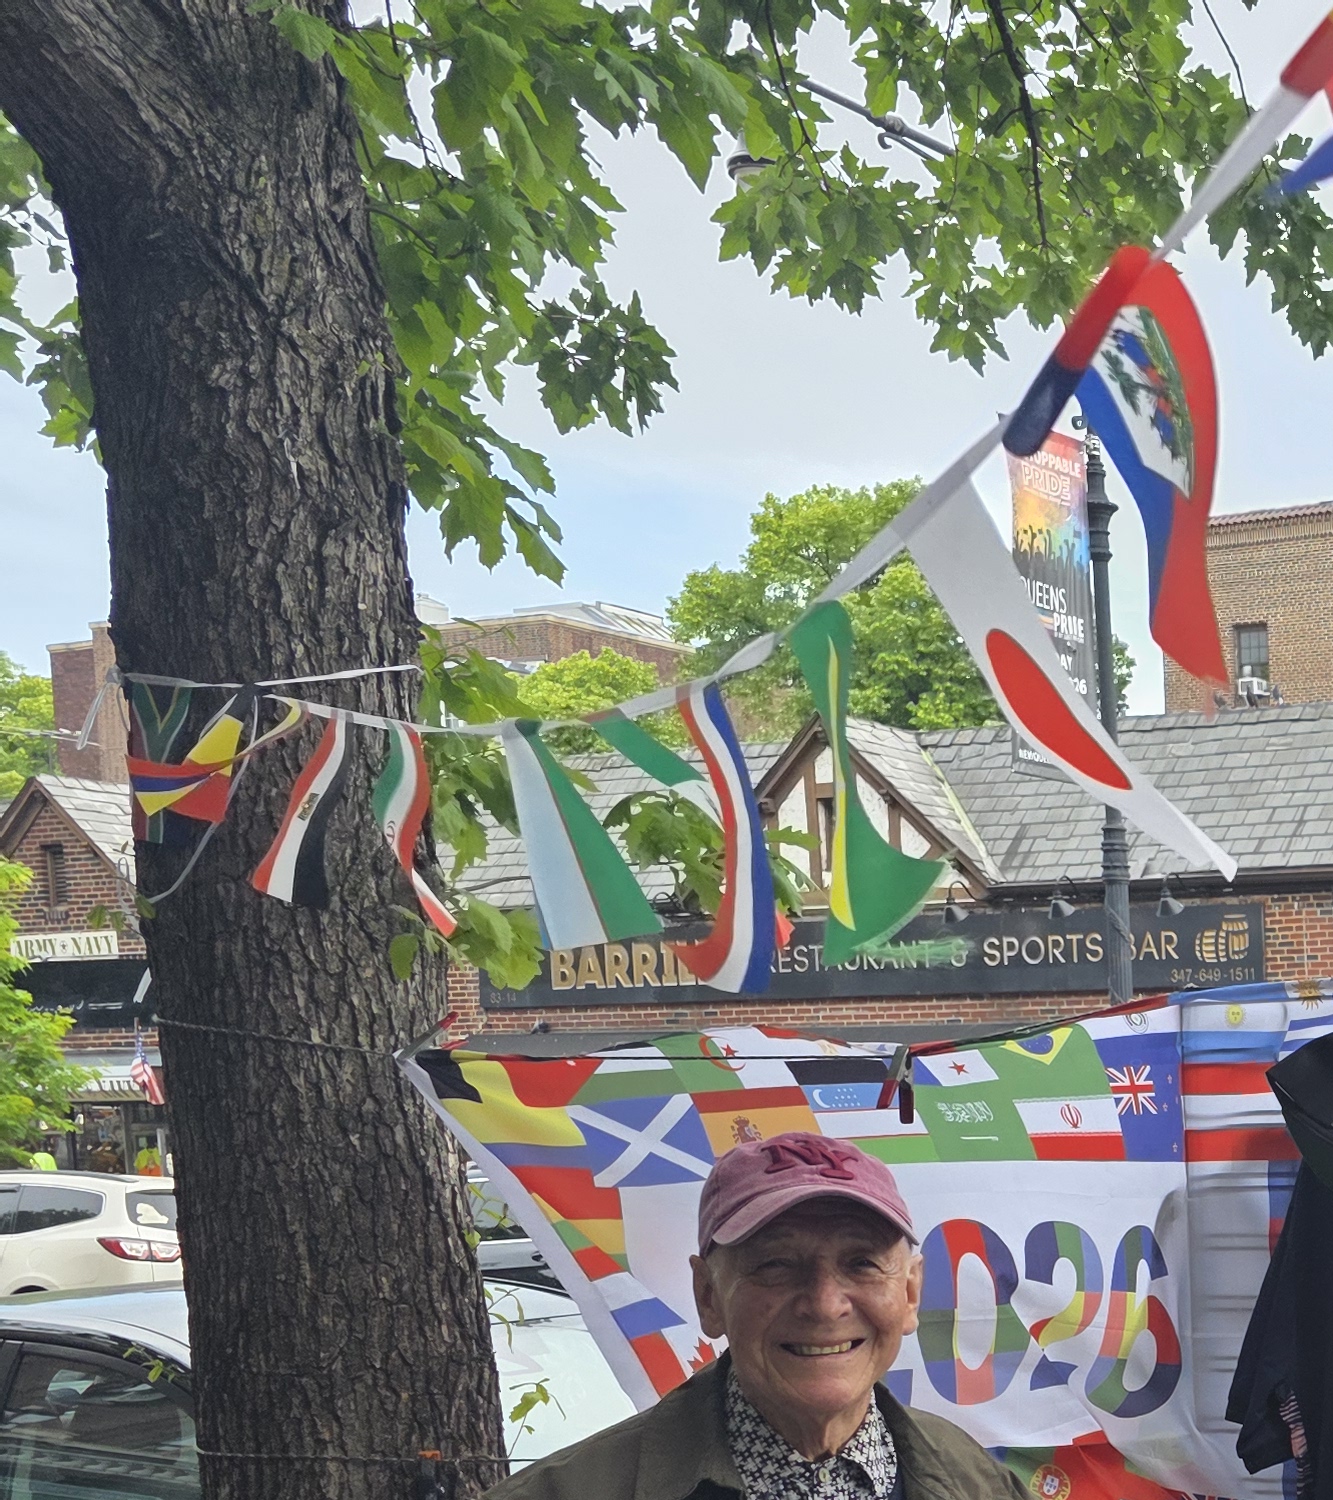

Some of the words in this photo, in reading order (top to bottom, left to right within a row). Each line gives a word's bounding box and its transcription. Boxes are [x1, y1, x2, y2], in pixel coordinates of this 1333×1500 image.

[71, 935, 115, 956] NAVY
[983, 932, 1104, 968] SPORTS
[1171, 967, 1257, 984] 347-649-1511
[886, 1217, 1182, 1419] 026
